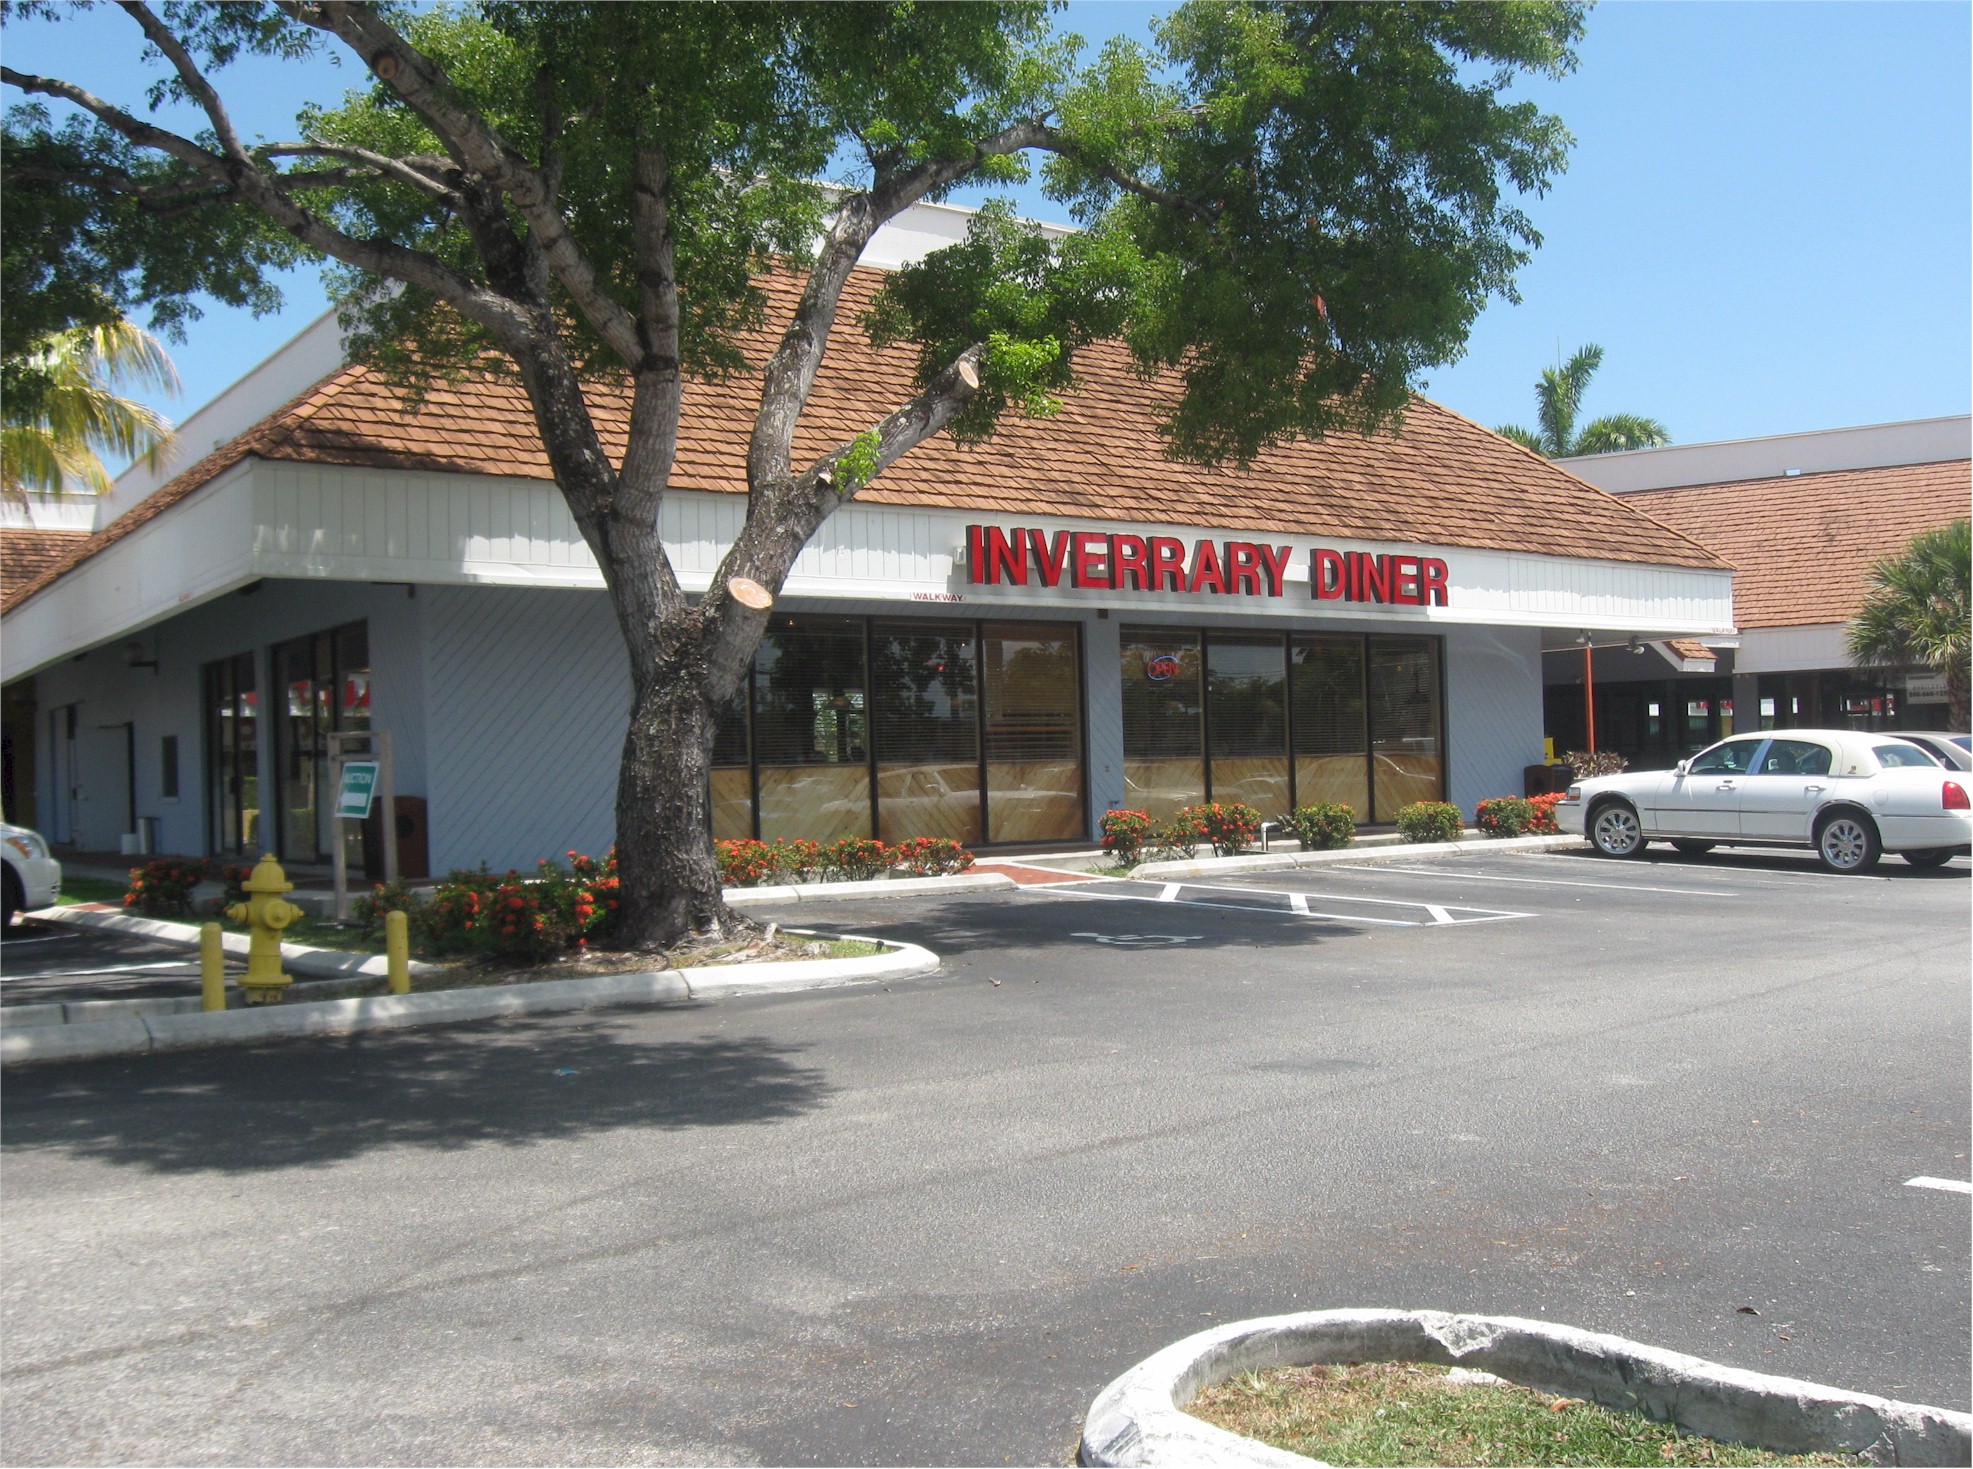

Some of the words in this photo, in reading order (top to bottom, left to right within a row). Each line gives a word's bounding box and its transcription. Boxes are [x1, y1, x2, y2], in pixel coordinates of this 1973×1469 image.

[965, 524, 1293, 597] INVERRARY
[1309, 548, 1449, 606] DINER
[912, 592, 964, 602] WALKWAY
[1147, 660, 1182, 675] OPEN
[343, 772, 373, 784] AUCTION
